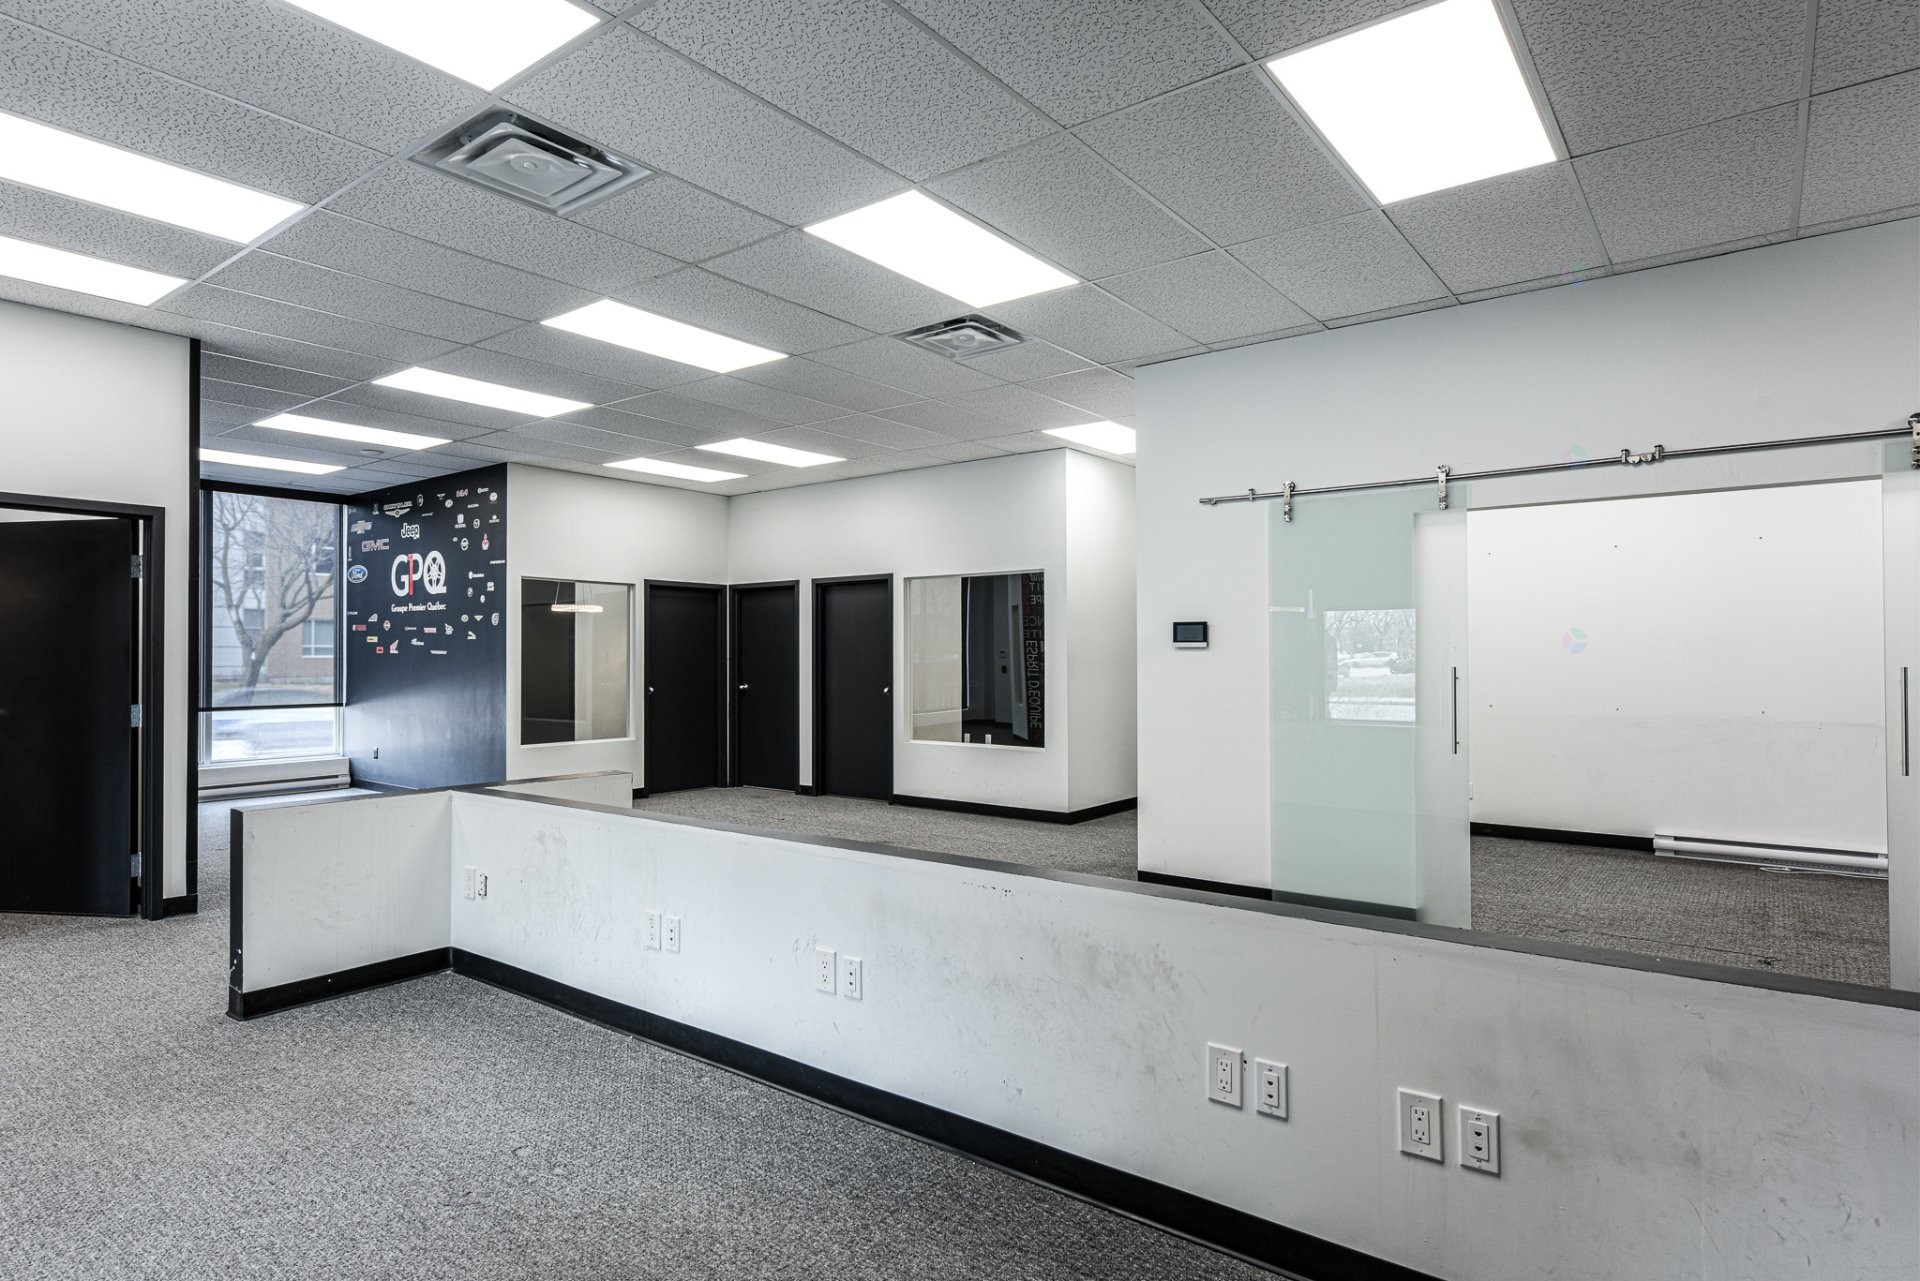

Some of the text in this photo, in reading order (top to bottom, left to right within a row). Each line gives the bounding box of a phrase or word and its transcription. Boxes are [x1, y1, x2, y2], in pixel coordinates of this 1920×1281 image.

[401, 523, 420, 539] Jeep
[362, 539, 389, 552] GMC
[391, 604, 408, 614] Groupe
[409, 602, 427, 611] Premier
